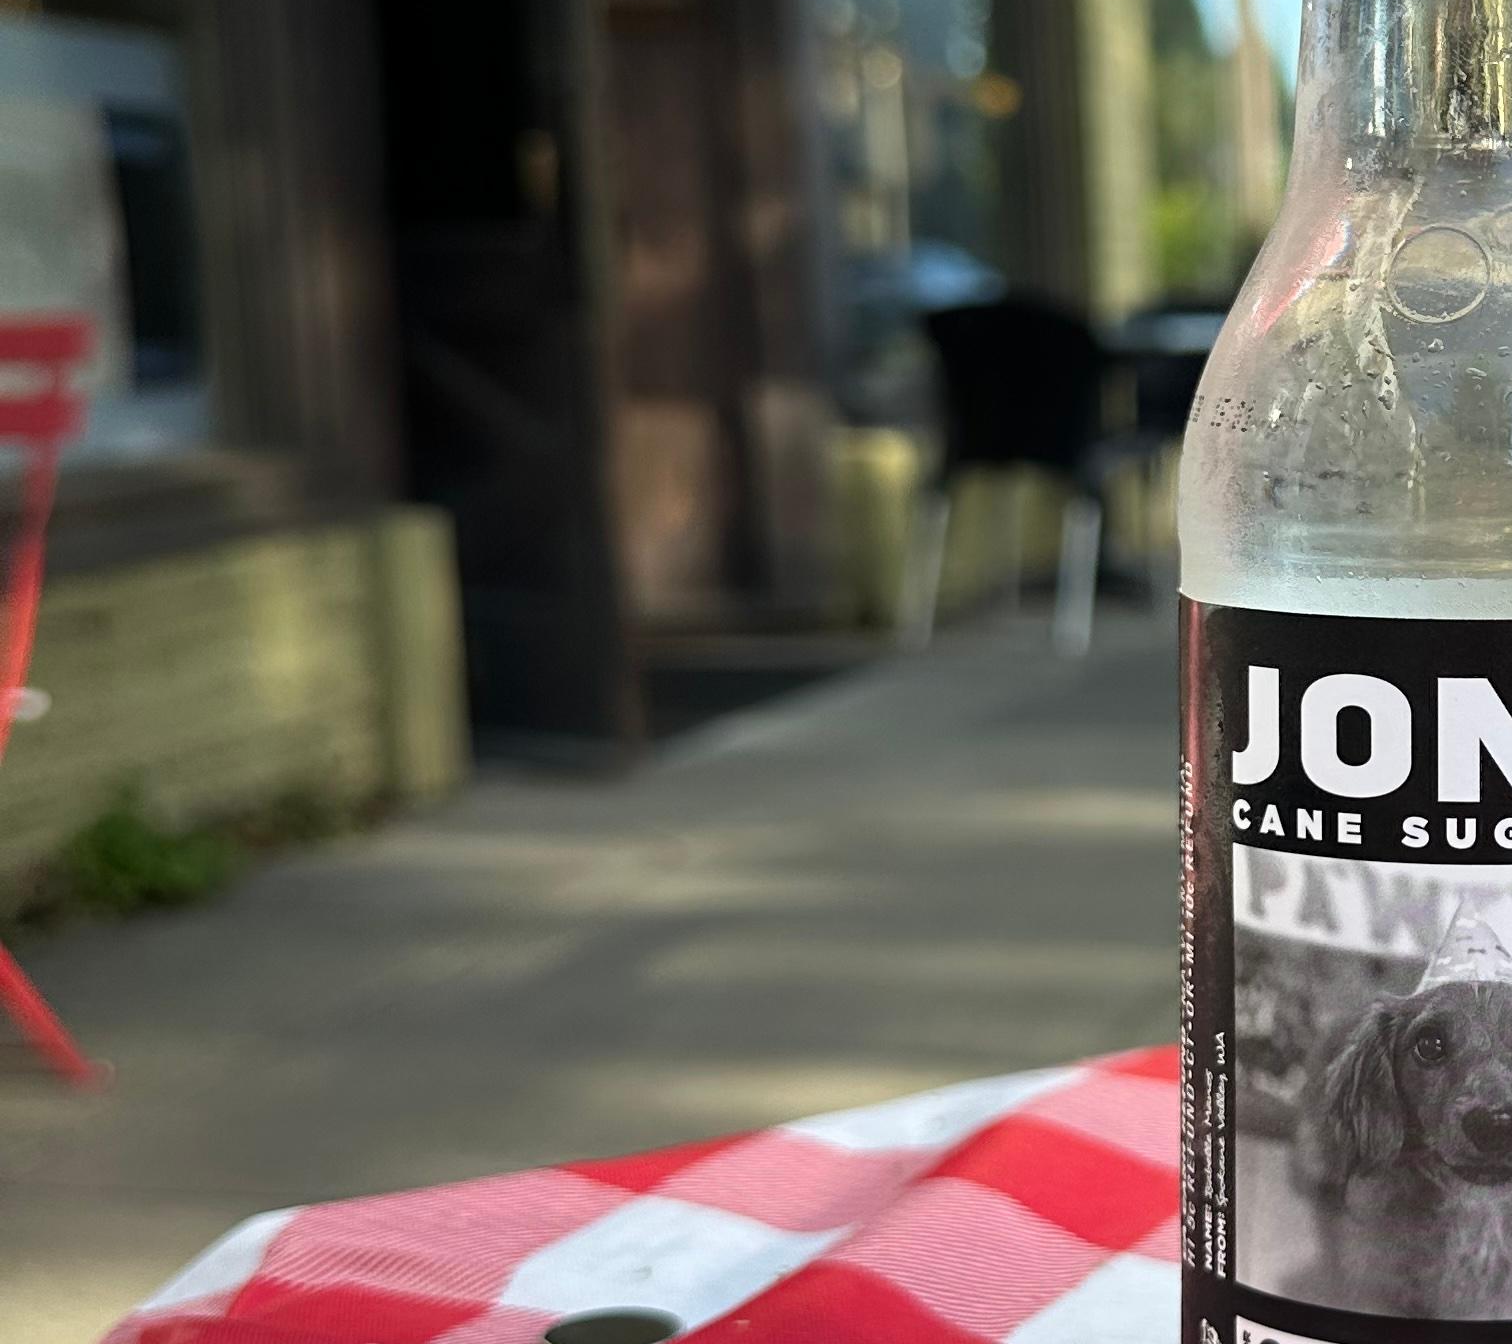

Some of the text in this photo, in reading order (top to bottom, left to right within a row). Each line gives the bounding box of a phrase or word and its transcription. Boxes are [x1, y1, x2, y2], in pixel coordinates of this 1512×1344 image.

[1233, 798, 1363, 845] CANE
[1216, 1032, 1225, 1065] WA
[1204, 1204, 1213, 1271] NAME:
[1217, 1211, 1226, 1279] FROM:
